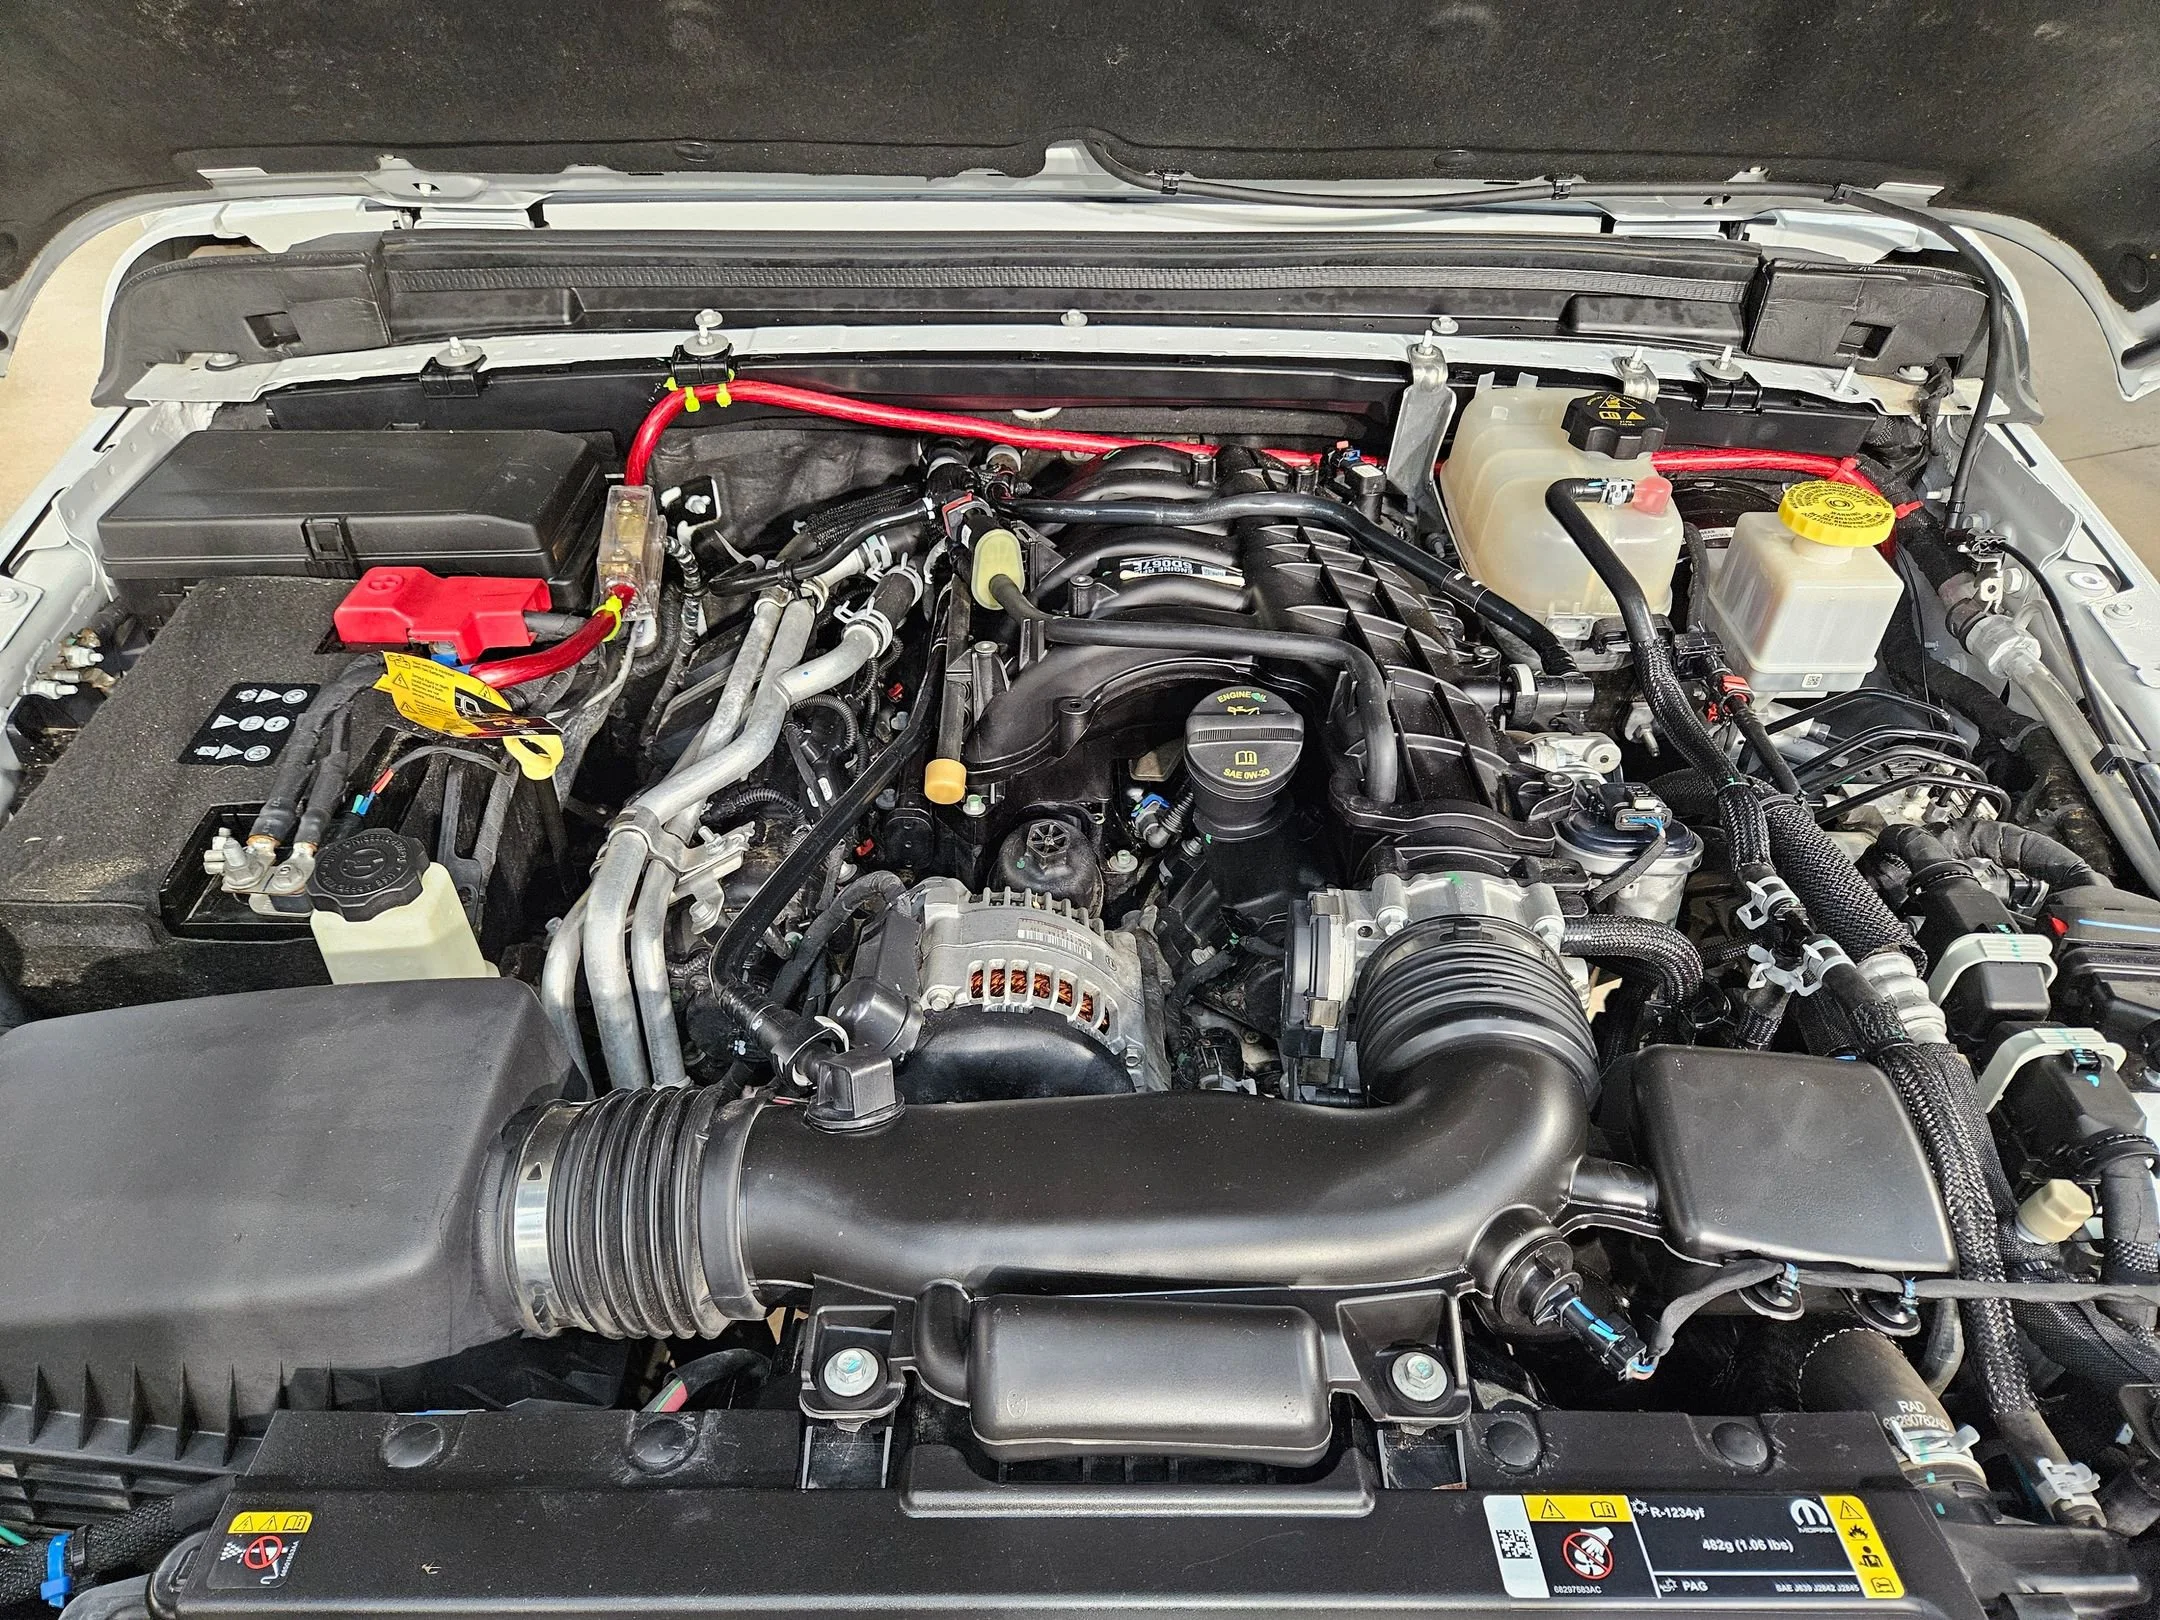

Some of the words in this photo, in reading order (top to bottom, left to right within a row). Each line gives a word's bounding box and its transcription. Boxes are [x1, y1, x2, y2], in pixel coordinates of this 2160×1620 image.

[1217, 691, 1251, 703] ENGINE
[1251, 692, 1268, 702] OIL
[1223, 768, 1242, 779] SAE
[1244, 768, 1270, 779] 0W-20
[1897, 1400, 1926, 1413] RAD
[1650, 1506, 1706, 1521] R-1234yf
[1702, 1538, 1734, 1553] 482g
[1735, 1538, 1767, 1553] (1.06
[1768, 1537, 1794, 1553] lbs)
[1682, 1580, 1708, 1592] PAG
[1775, 1582, 1794, 1593] SAE
